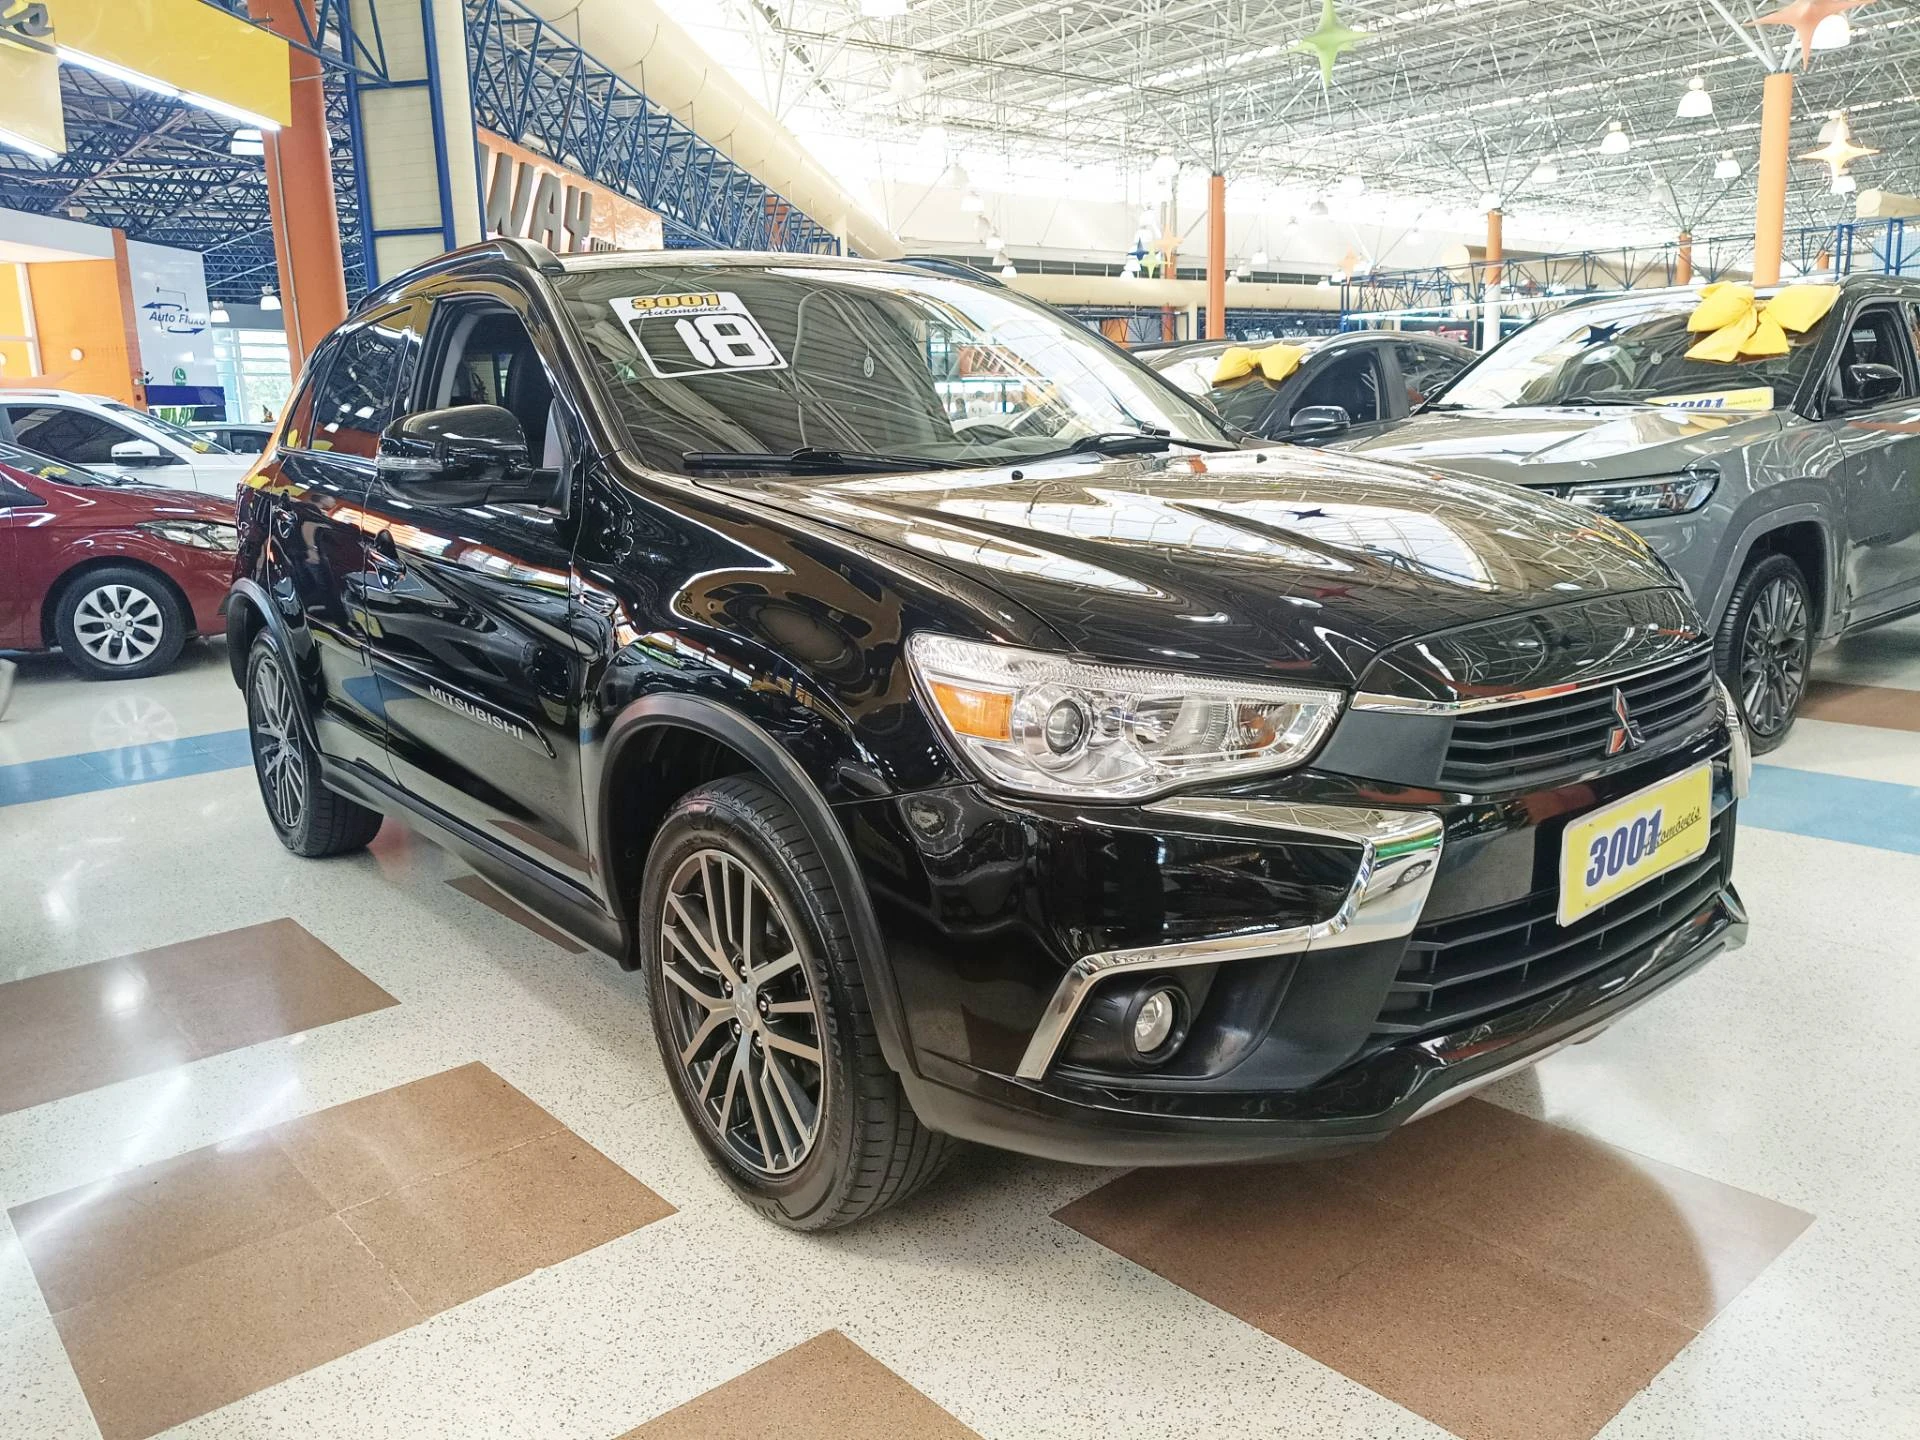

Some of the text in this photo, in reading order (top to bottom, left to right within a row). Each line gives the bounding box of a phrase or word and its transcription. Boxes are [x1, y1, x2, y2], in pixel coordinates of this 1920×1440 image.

[478, 142, 592, 252] WAY
[149, 311, 206, 326] Auto Fluxo
[631, 294, 721, 309] 3001
[674, 314, 775, 367] 18
[429, 684, 523, 740] MITSUBISHI
[1586, 808, 1662, 887] 3001
